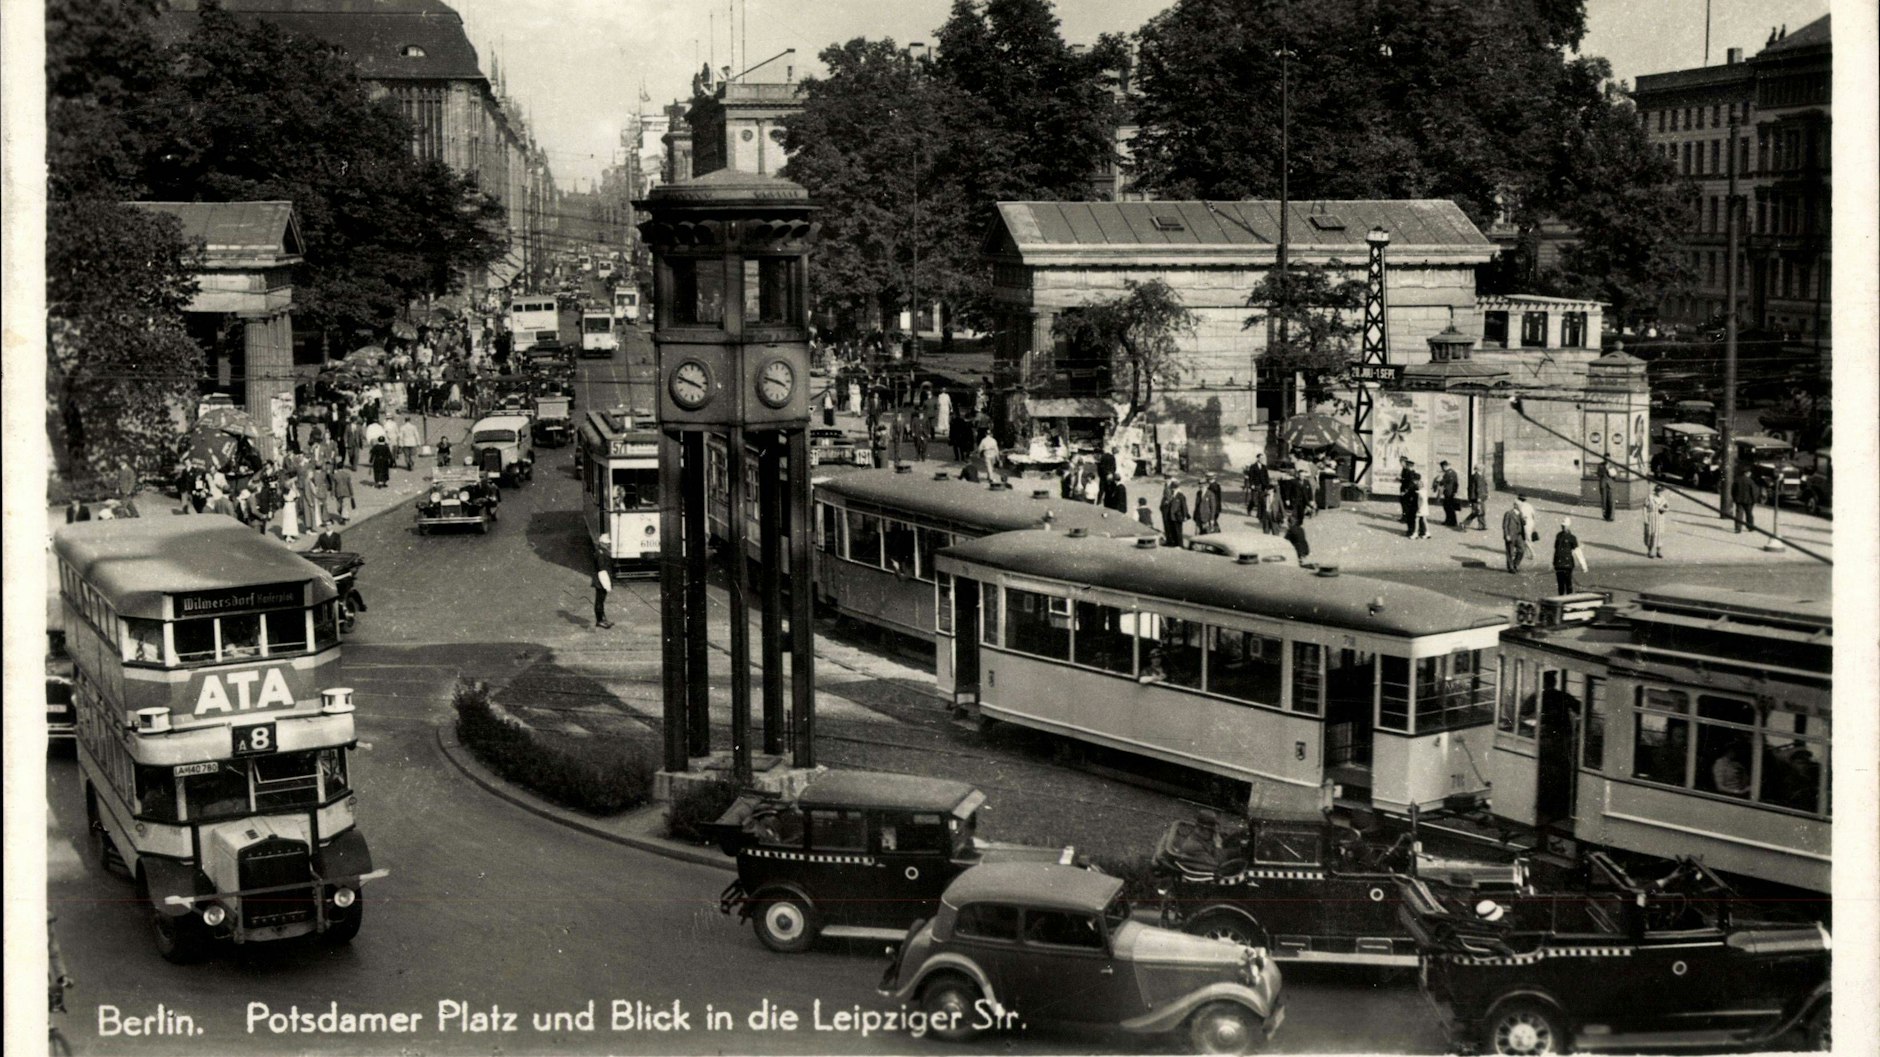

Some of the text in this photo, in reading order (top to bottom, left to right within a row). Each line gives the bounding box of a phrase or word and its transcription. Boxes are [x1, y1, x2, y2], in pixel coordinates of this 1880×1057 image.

[183, 592, 255, 611] Wilmersdorf
[194, 668, 295, 715] ATA
[238, 727, 270, 752] A 8
